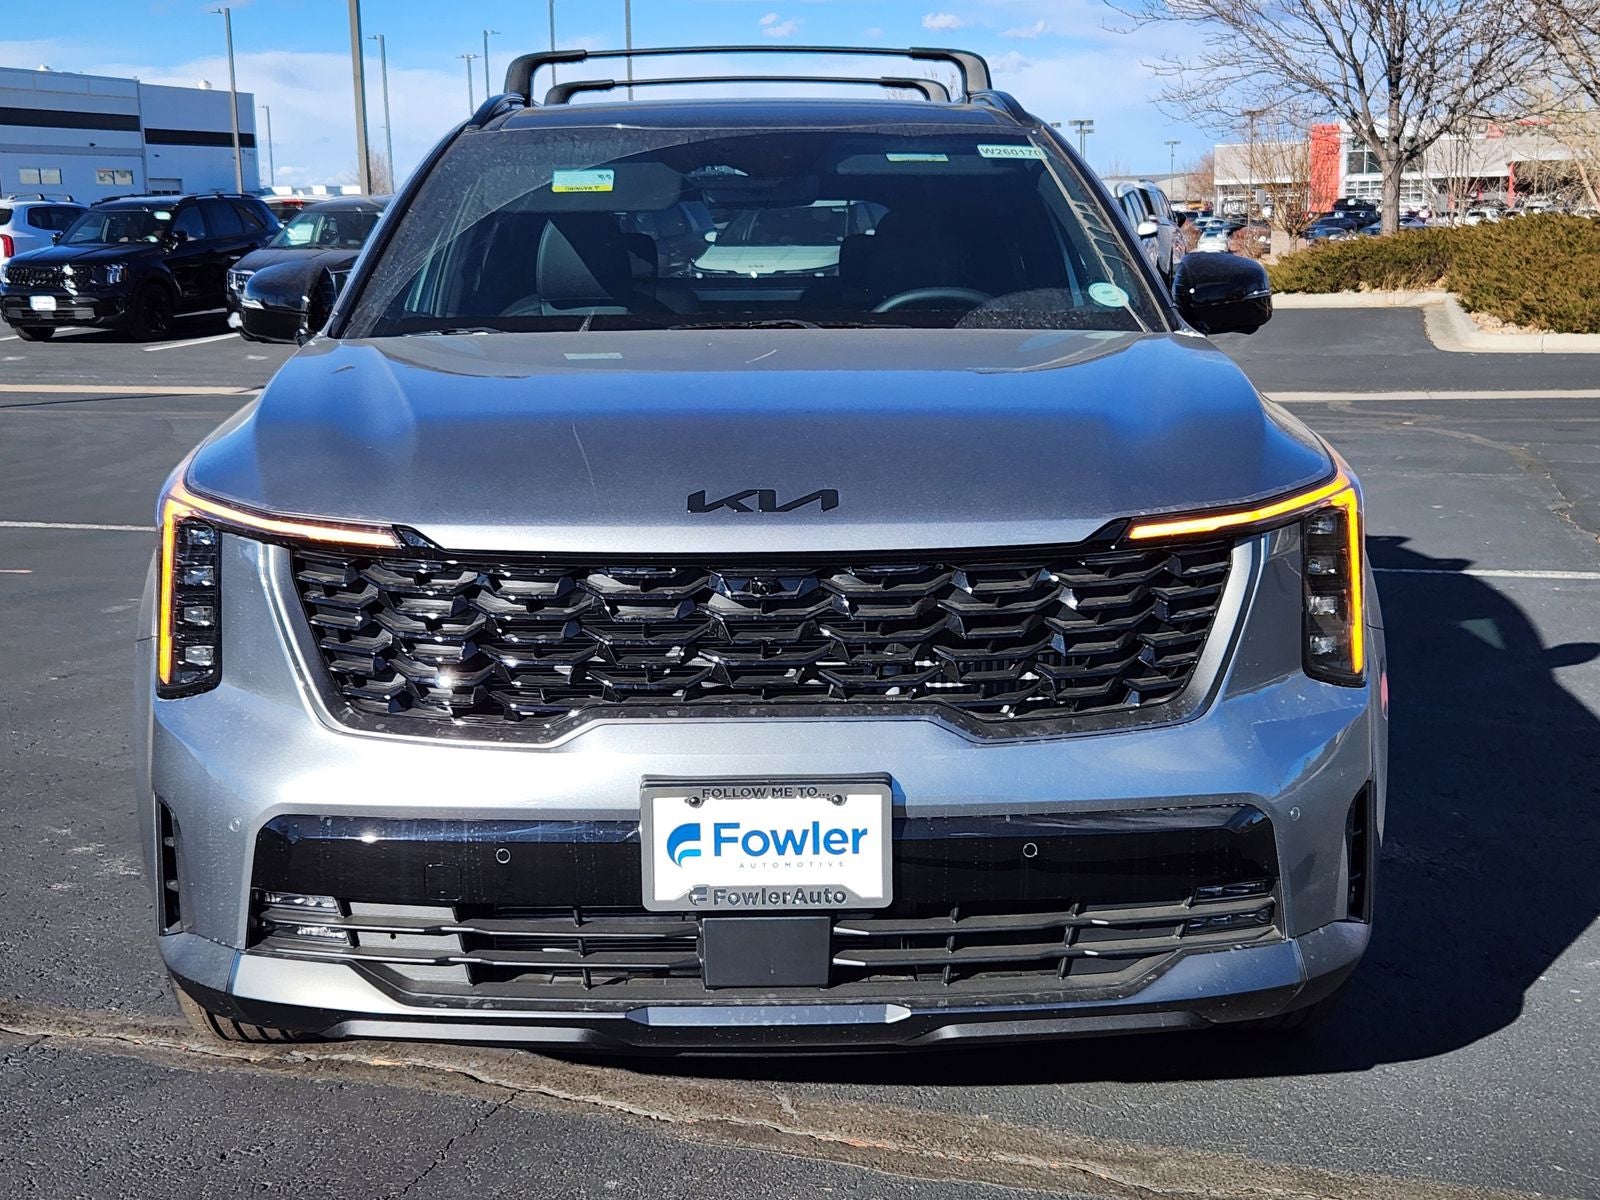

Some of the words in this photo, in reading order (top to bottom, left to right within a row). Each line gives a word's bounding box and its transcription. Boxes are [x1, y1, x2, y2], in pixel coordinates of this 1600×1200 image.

[687, 489, 839, 513] KIA
[702, 787, 766, 799] FOLLOW
[772, 787, 793, 797] ME
[797, 786, 830, 797] TO...
[713, 820, 868, 857] Fowler
[739, 861, 845, 869] AUTOMOTIVE
[713, 887, 847, 905] FowlerAuto
